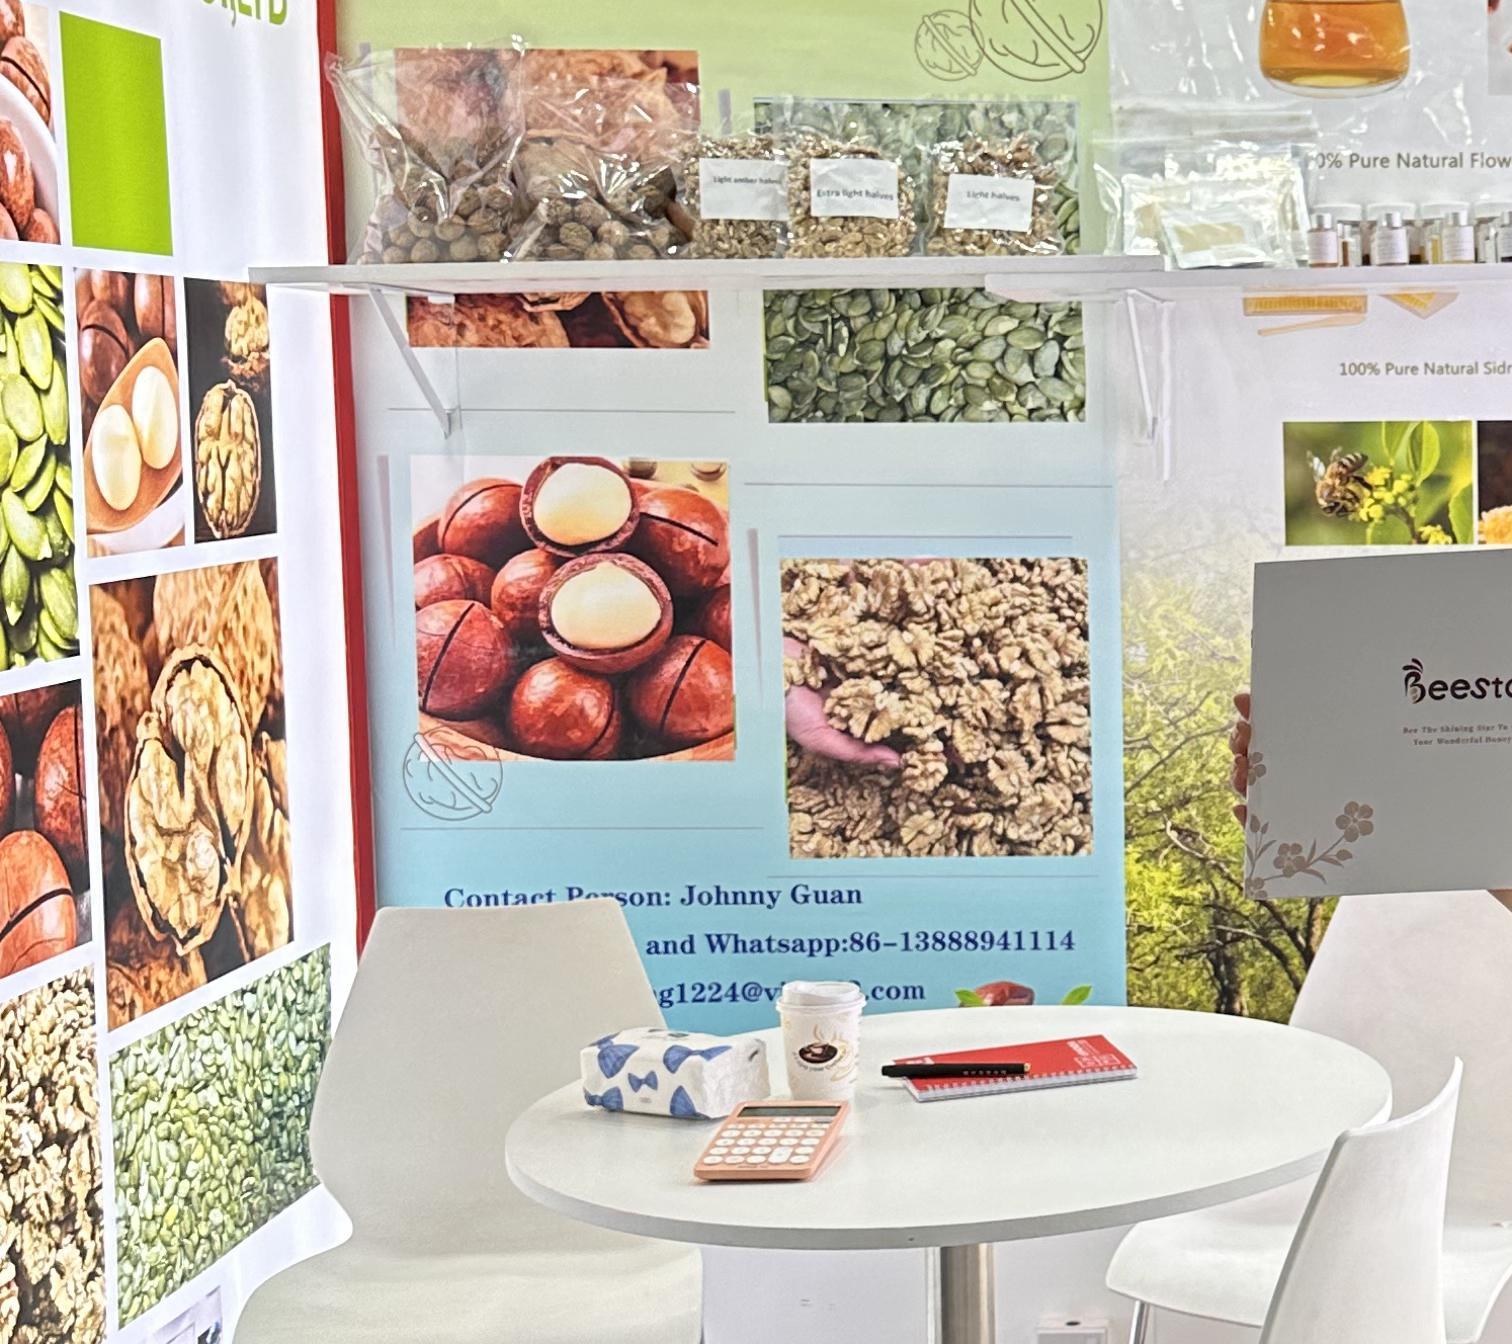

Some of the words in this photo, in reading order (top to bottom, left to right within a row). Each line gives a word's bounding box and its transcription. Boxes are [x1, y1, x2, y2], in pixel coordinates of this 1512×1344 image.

[1348, 152, 1392, 170] Pure
[1396, 151, 1464, 169] Natural
[1339, 361, 1382, 377] 100%
[1384, 361, 1420, 376] Pure
[1423, 360, 1480, 376] Natural
[1482, 360, 1512, 376] Sidr
[645, 933, 697, 956] and
